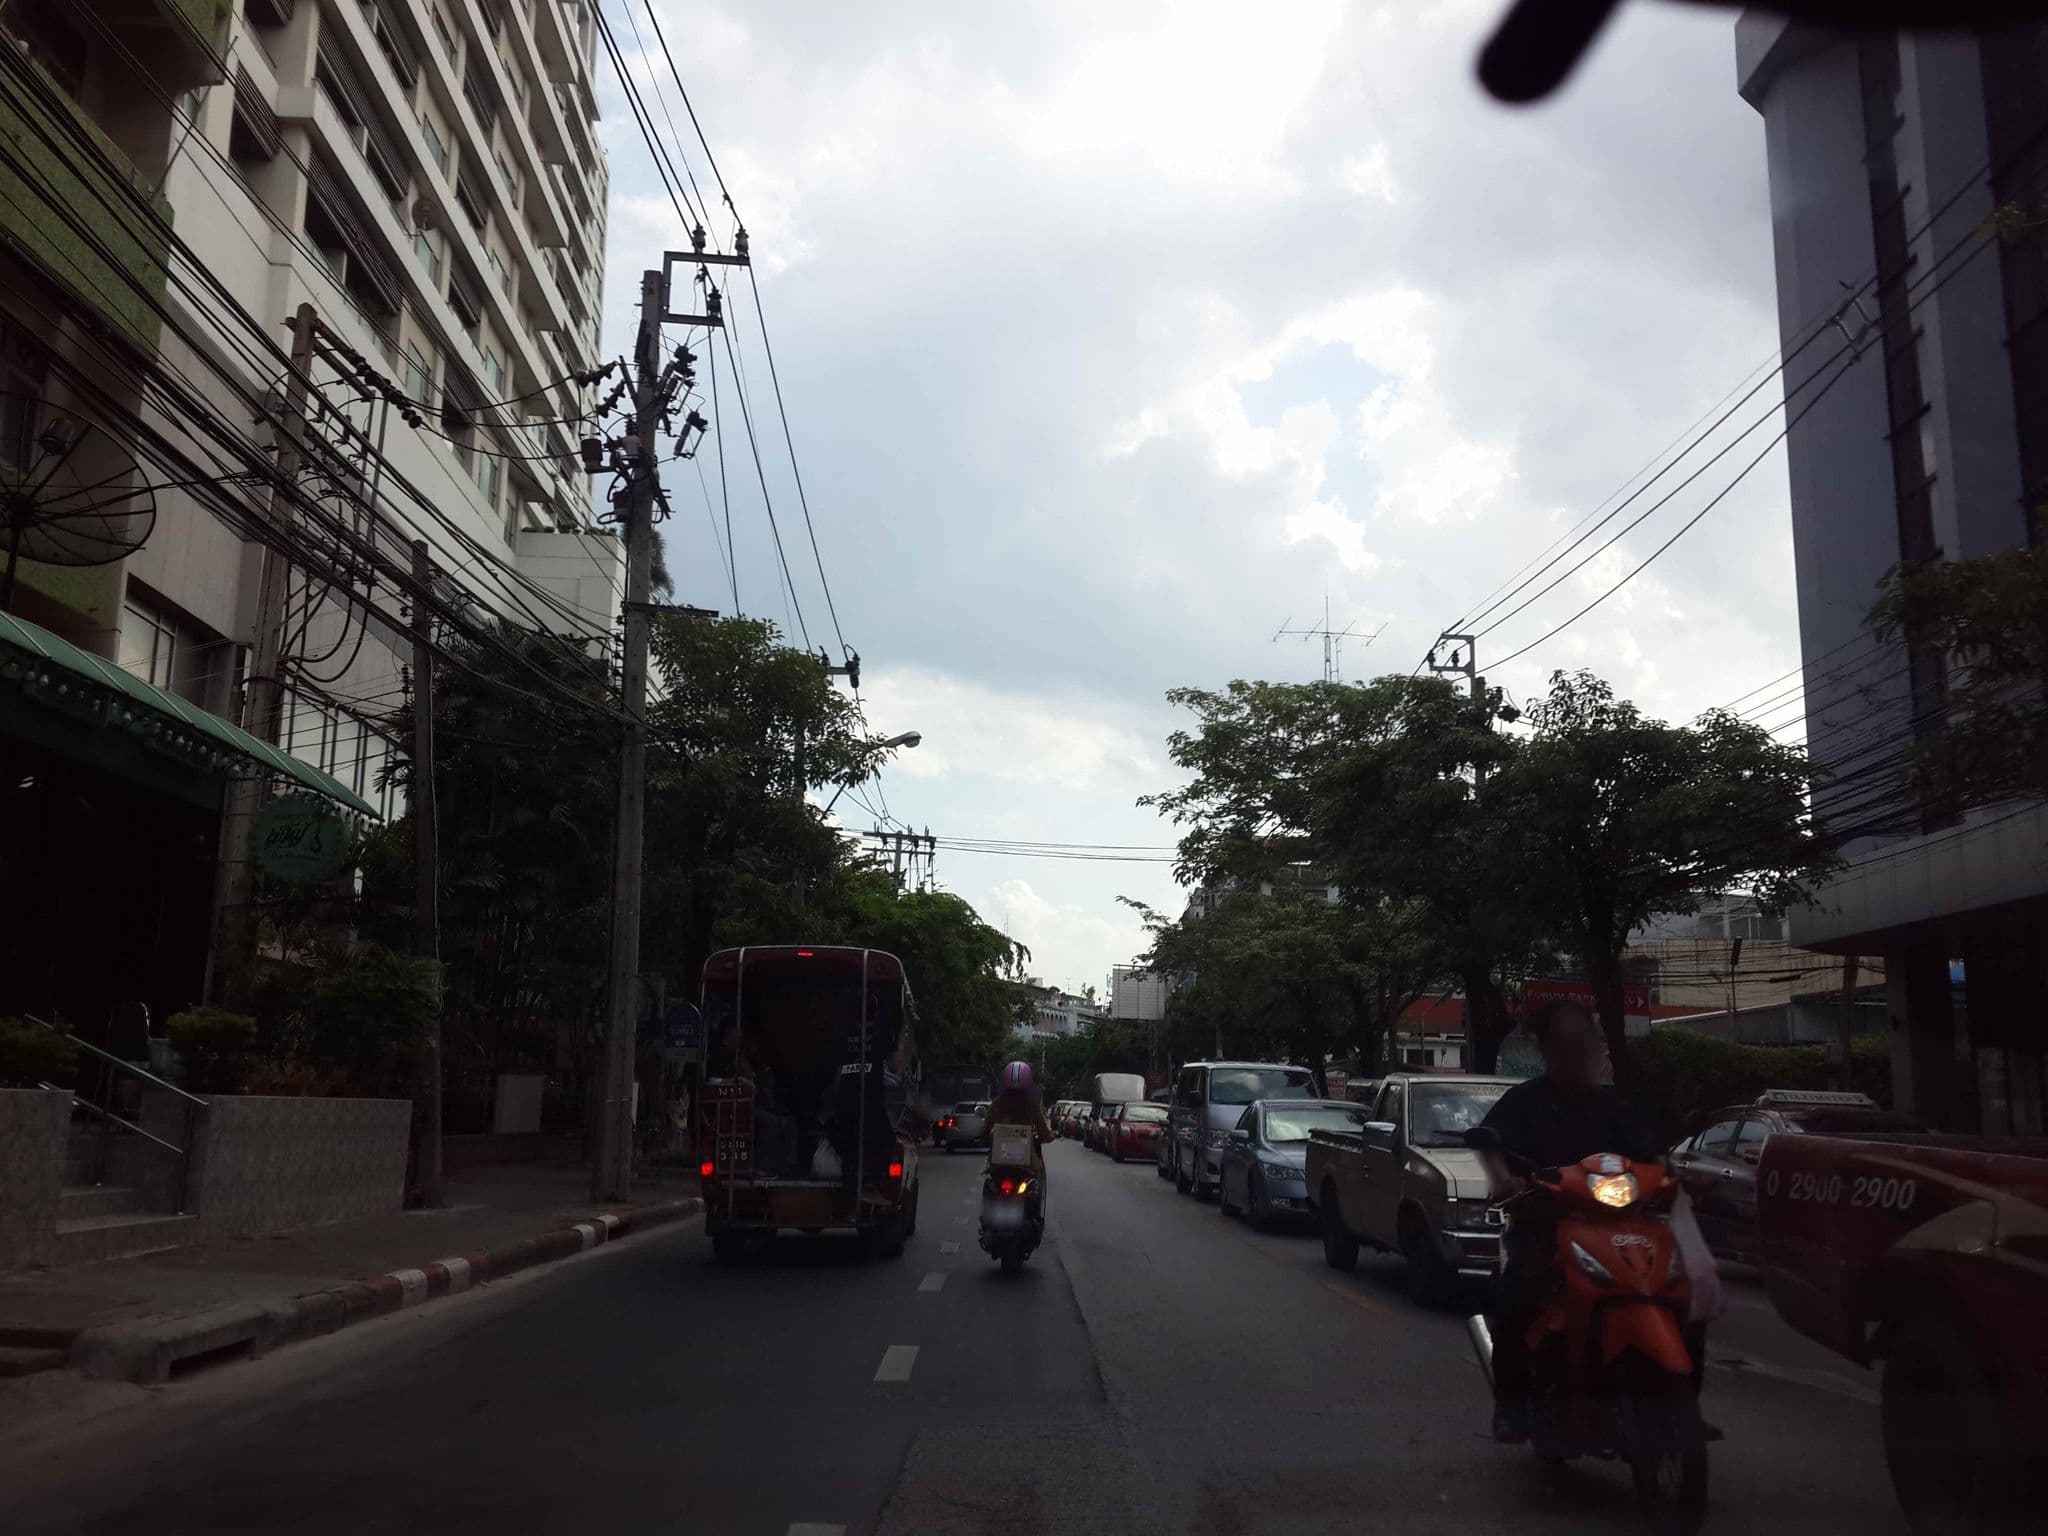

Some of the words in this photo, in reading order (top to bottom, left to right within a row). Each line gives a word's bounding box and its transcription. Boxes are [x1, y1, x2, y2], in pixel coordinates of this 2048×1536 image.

[1568, 992, 1597, 1002] PARK
[1767, 1169, 1779, 1196] 0
[1788, 1171, 1841, 1204] 2900
[1850, 1176, 1917, 1211] 2900
